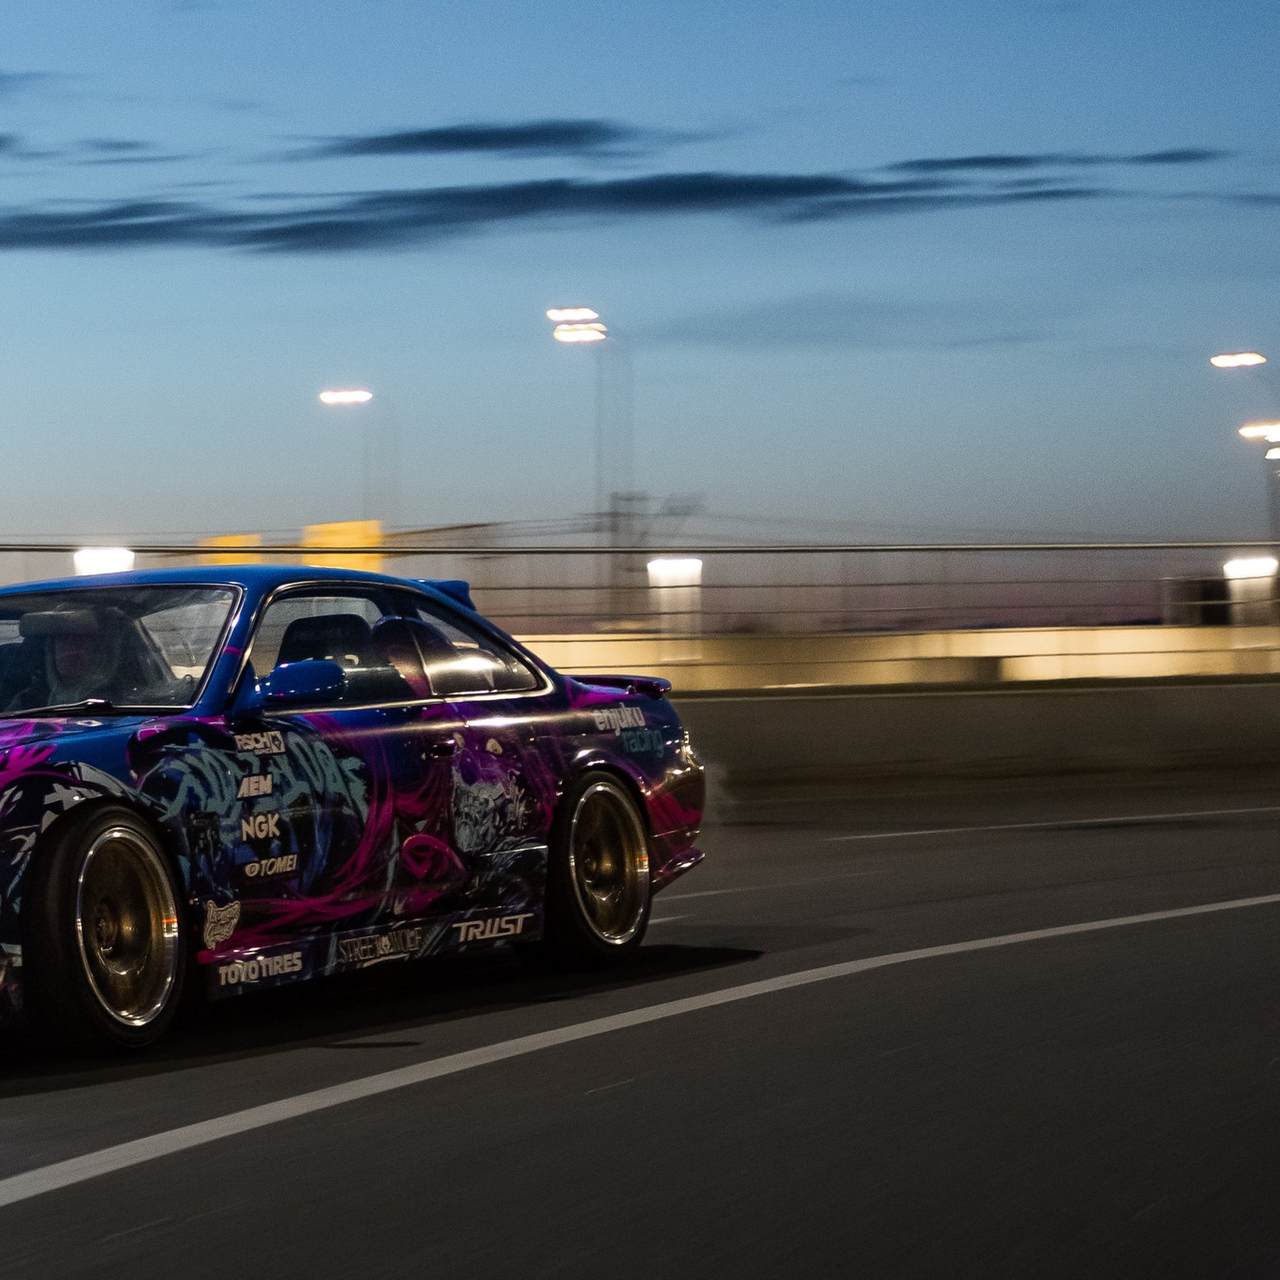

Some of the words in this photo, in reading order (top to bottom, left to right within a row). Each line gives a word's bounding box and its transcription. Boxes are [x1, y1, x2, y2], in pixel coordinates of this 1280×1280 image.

[595, 702, 646, 736] enjuku
[237, 774, 273, 798] AEM
[241, 813, 281, 841] NGK
[260, 854, 297, 876] TOMEI
[452, 912, 534, 943] TRUST
[219, 960, 260, 985] TOYO
[260, 951, 302, 977] TIRES
